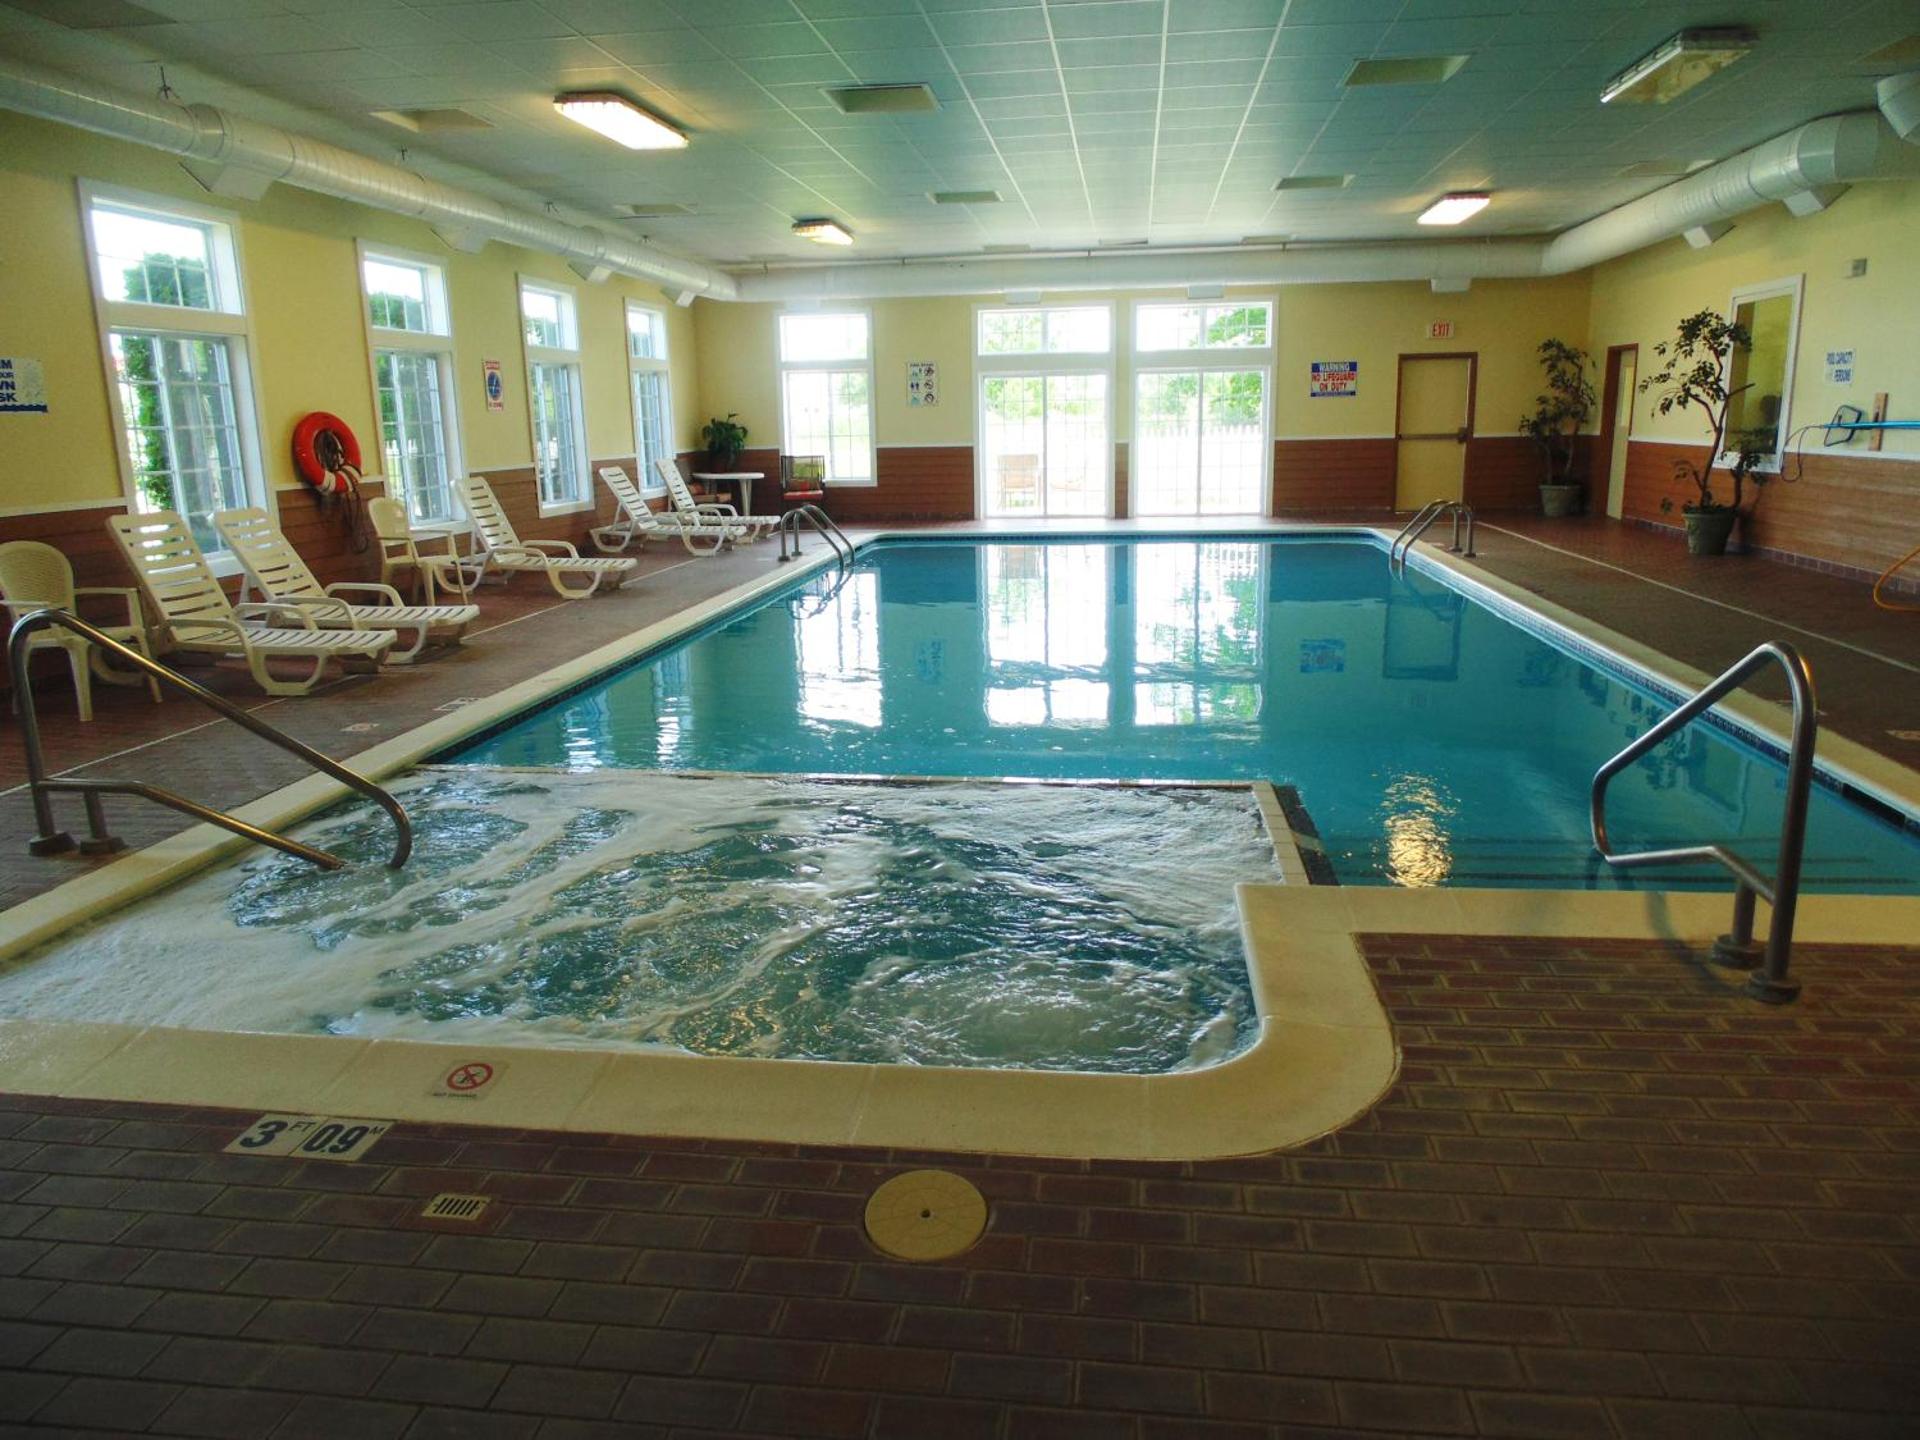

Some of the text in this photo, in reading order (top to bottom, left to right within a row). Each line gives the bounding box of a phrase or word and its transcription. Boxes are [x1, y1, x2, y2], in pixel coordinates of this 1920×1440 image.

[1432, 322, 1450, 337] EXIT
[1319, 361, 1350, 372] WARNING
[1311, 372, 1356, 382] NO LIFEGUARD
[1319, 382, 1347, 392] ON DUTY
[239, 1120, 289, 1148] 3
[289, 1121, 317, 1133] FT
[368, 1125, 386, 1136] M
